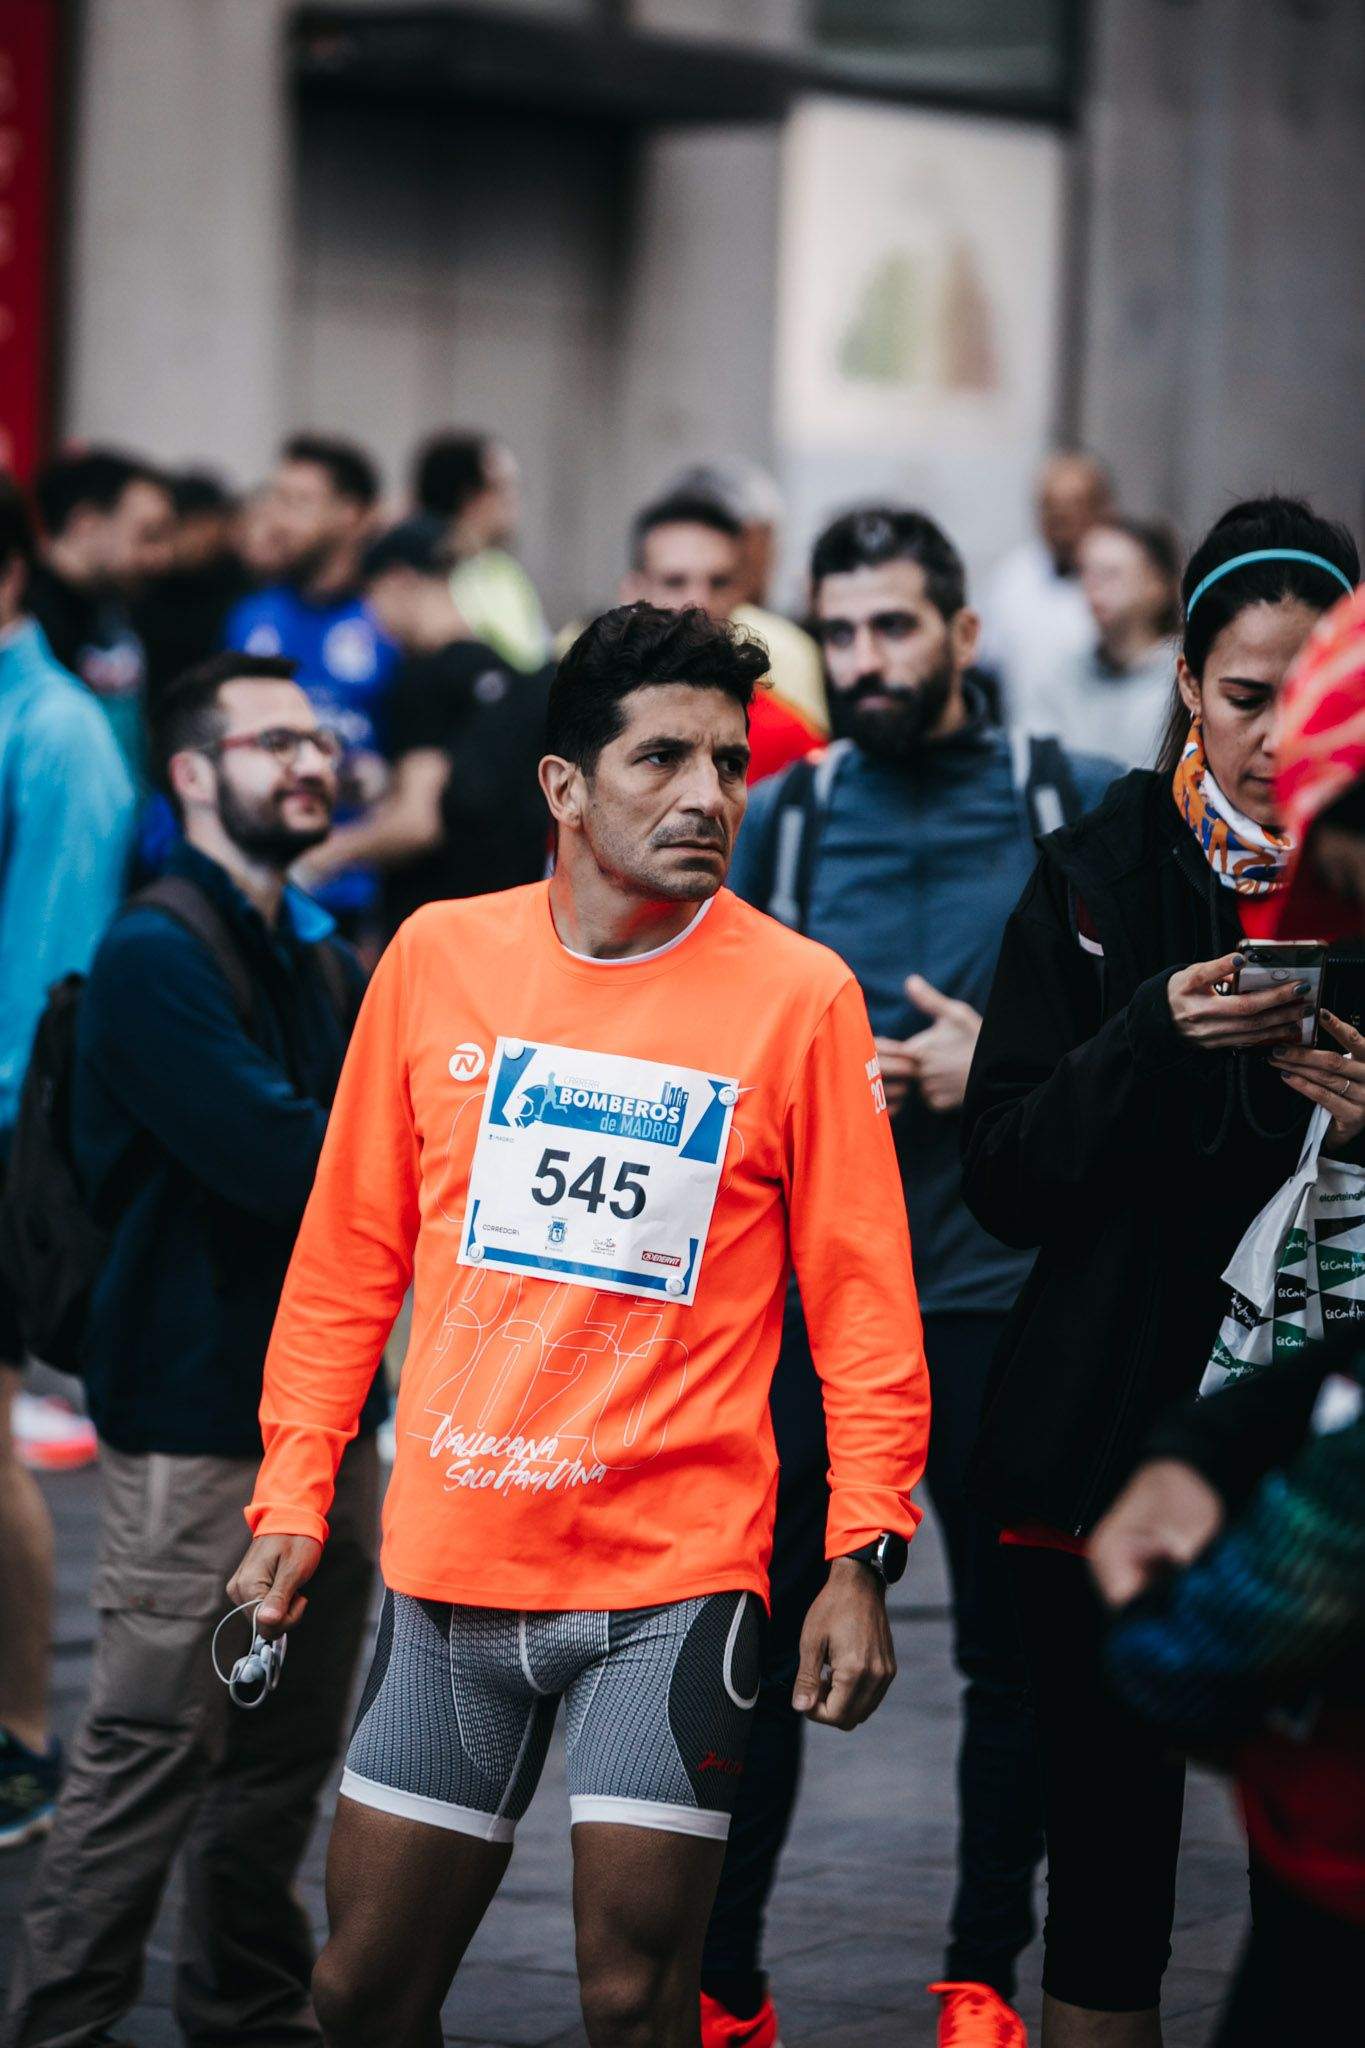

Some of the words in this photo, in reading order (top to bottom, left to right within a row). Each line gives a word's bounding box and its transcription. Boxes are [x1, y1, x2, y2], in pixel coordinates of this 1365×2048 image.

[559, 1087, 681, 1124] BOMBEROS
[599, 1113, 617, 1132] de
[619, 1115, 678, 1143] MADRID
[531, 1147, 651, 1220] 545
[653, 1253, 681, 1266] ENERVIT
[1330, 1260, 1350, 1271] Corte
[1334, 1308, 1355, 1319] Corte
